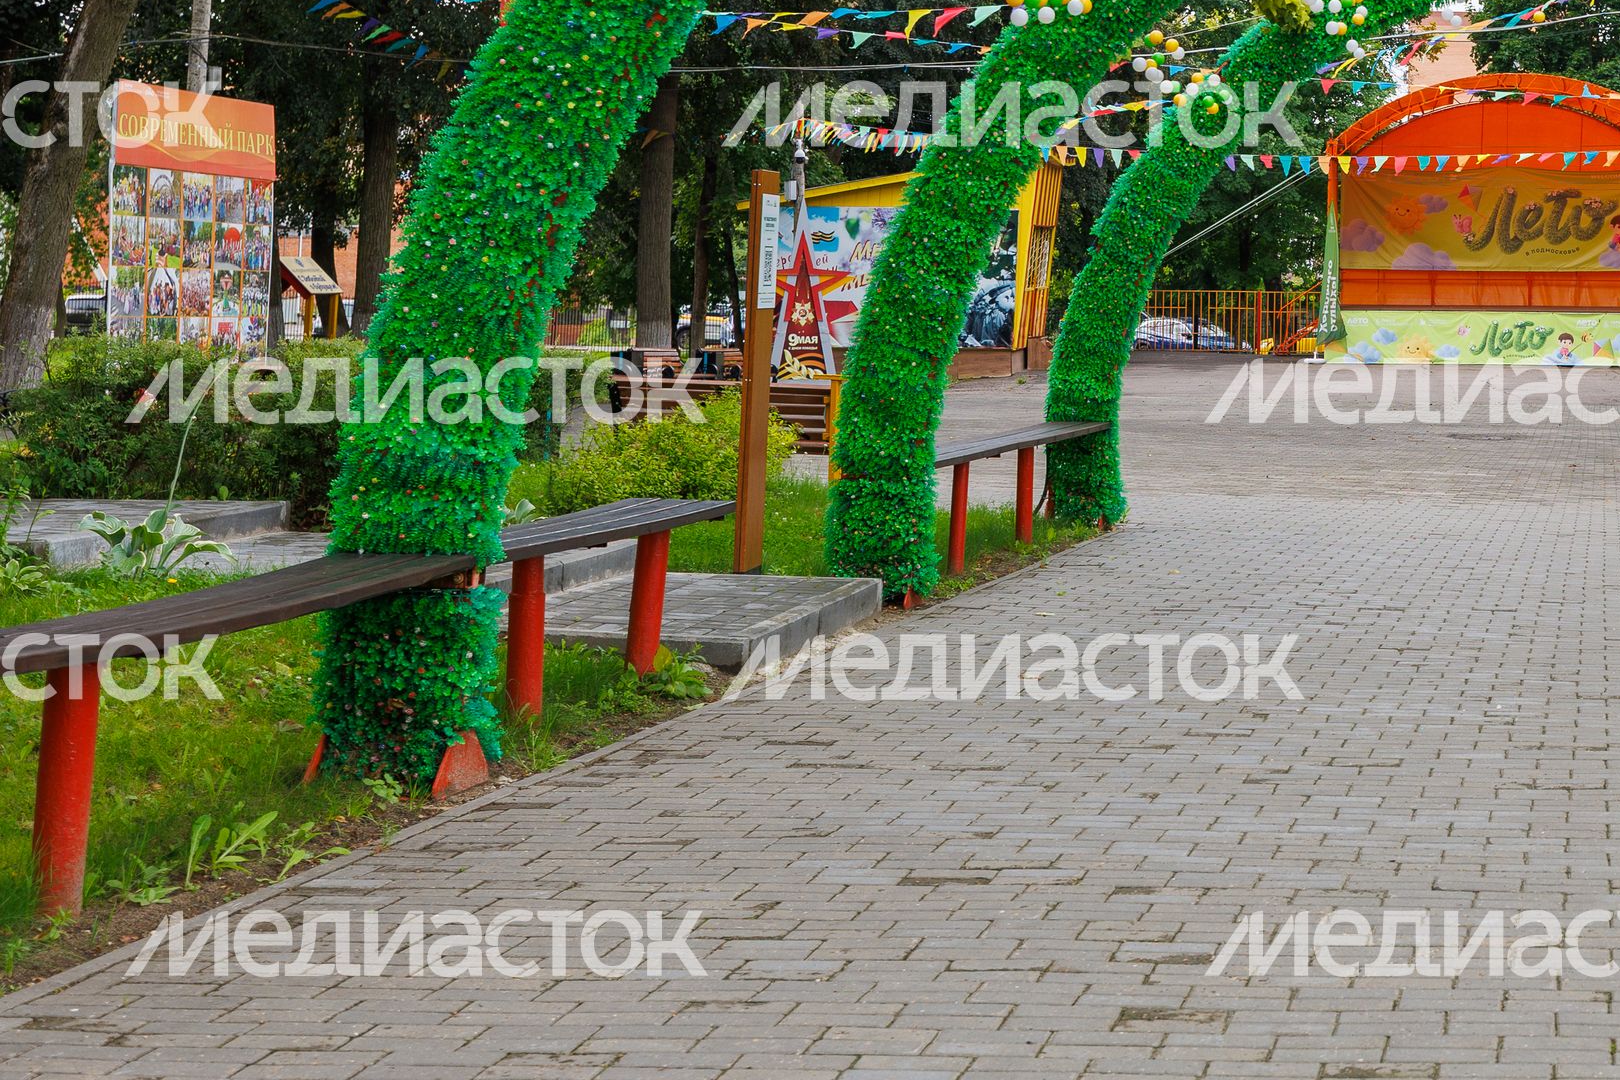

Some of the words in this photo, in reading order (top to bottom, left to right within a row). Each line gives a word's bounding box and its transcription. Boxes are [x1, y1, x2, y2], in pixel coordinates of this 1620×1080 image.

[119, 113, 233, 150] СОВРЕМЕННЫЙ
[237, 131, 274, 155] ПАРК
[1463, 186, 1619, 255] Лето
[1469, 320, 1554, 357] Лето
